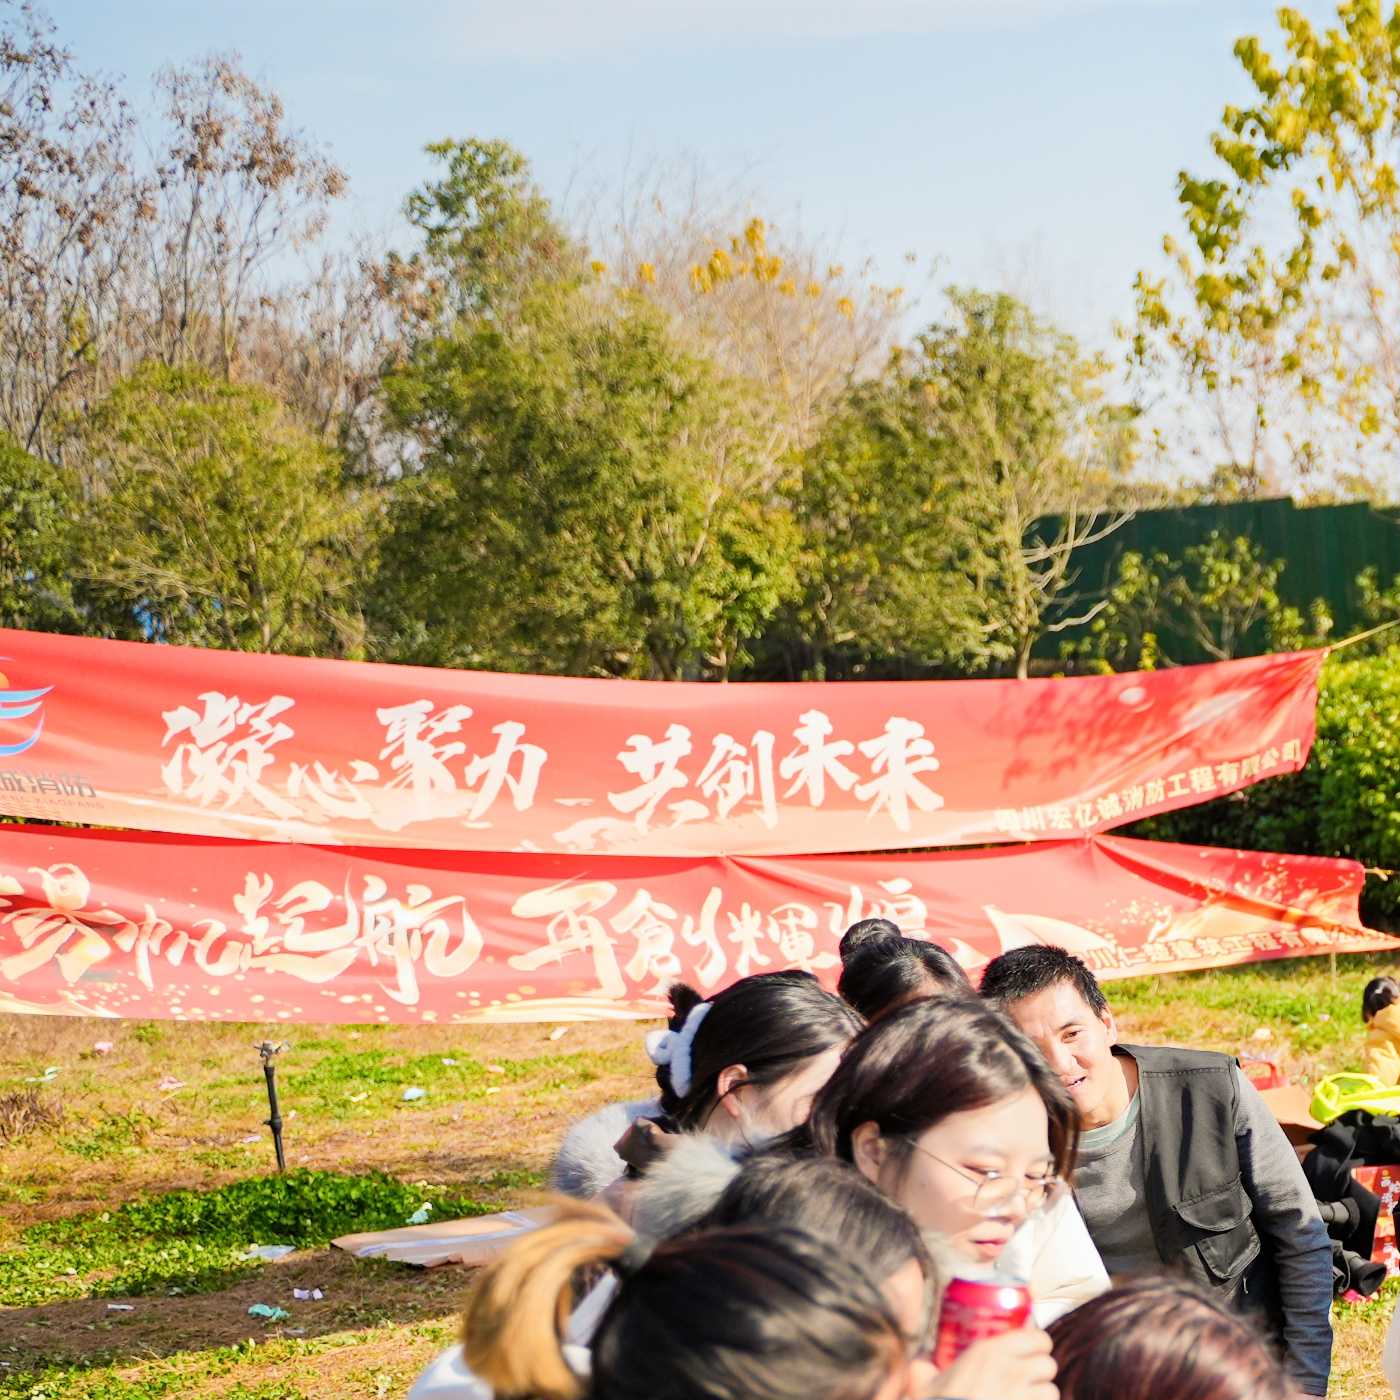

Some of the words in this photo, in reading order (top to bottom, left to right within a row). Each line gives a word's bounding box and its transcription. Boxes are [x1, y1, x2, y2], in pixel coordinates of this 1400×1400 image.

[160, 690, 549, 834] 凝心聚力
[607, 708, 944, 834] 共创未来
